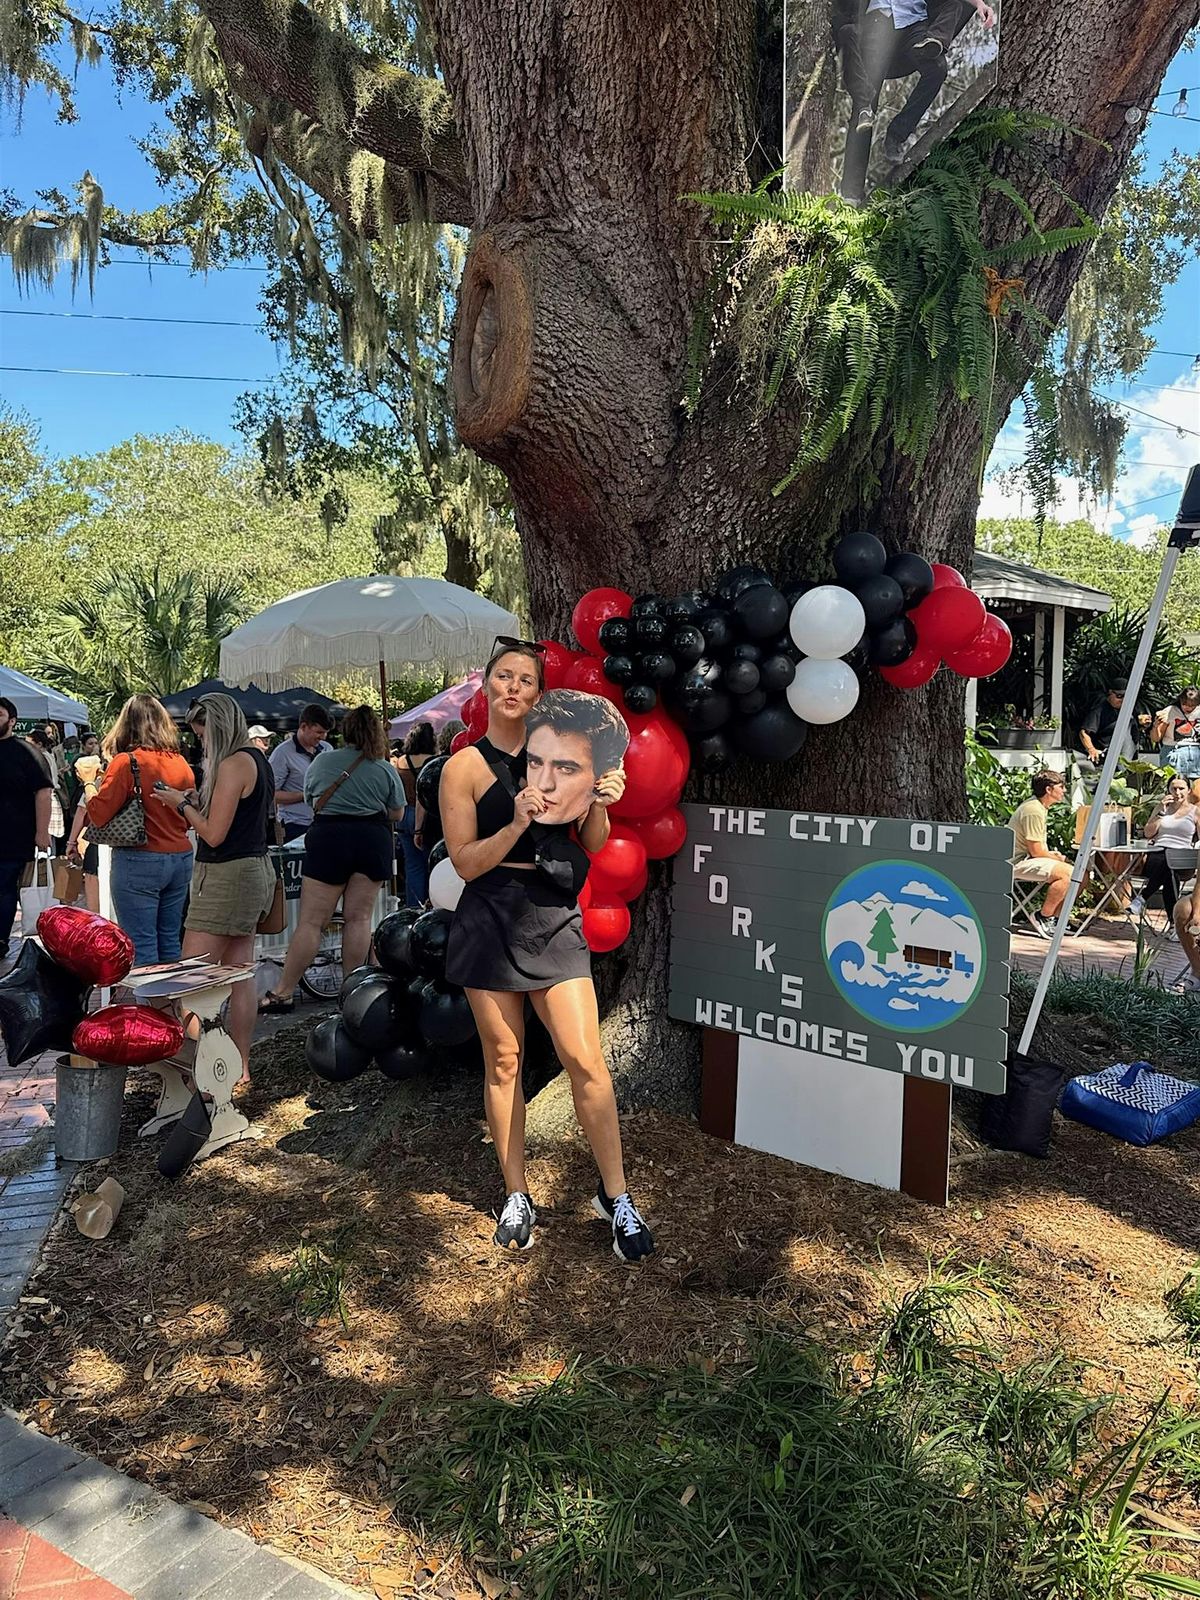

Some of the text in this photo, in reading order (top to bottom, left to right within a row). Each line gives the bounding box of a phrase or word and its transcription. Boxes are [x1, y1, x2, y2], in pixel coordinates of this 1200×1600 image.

[709, 807, 961, 853] THE CITY OF
[695, 997, 974, 1087] WELCOMES YOU
